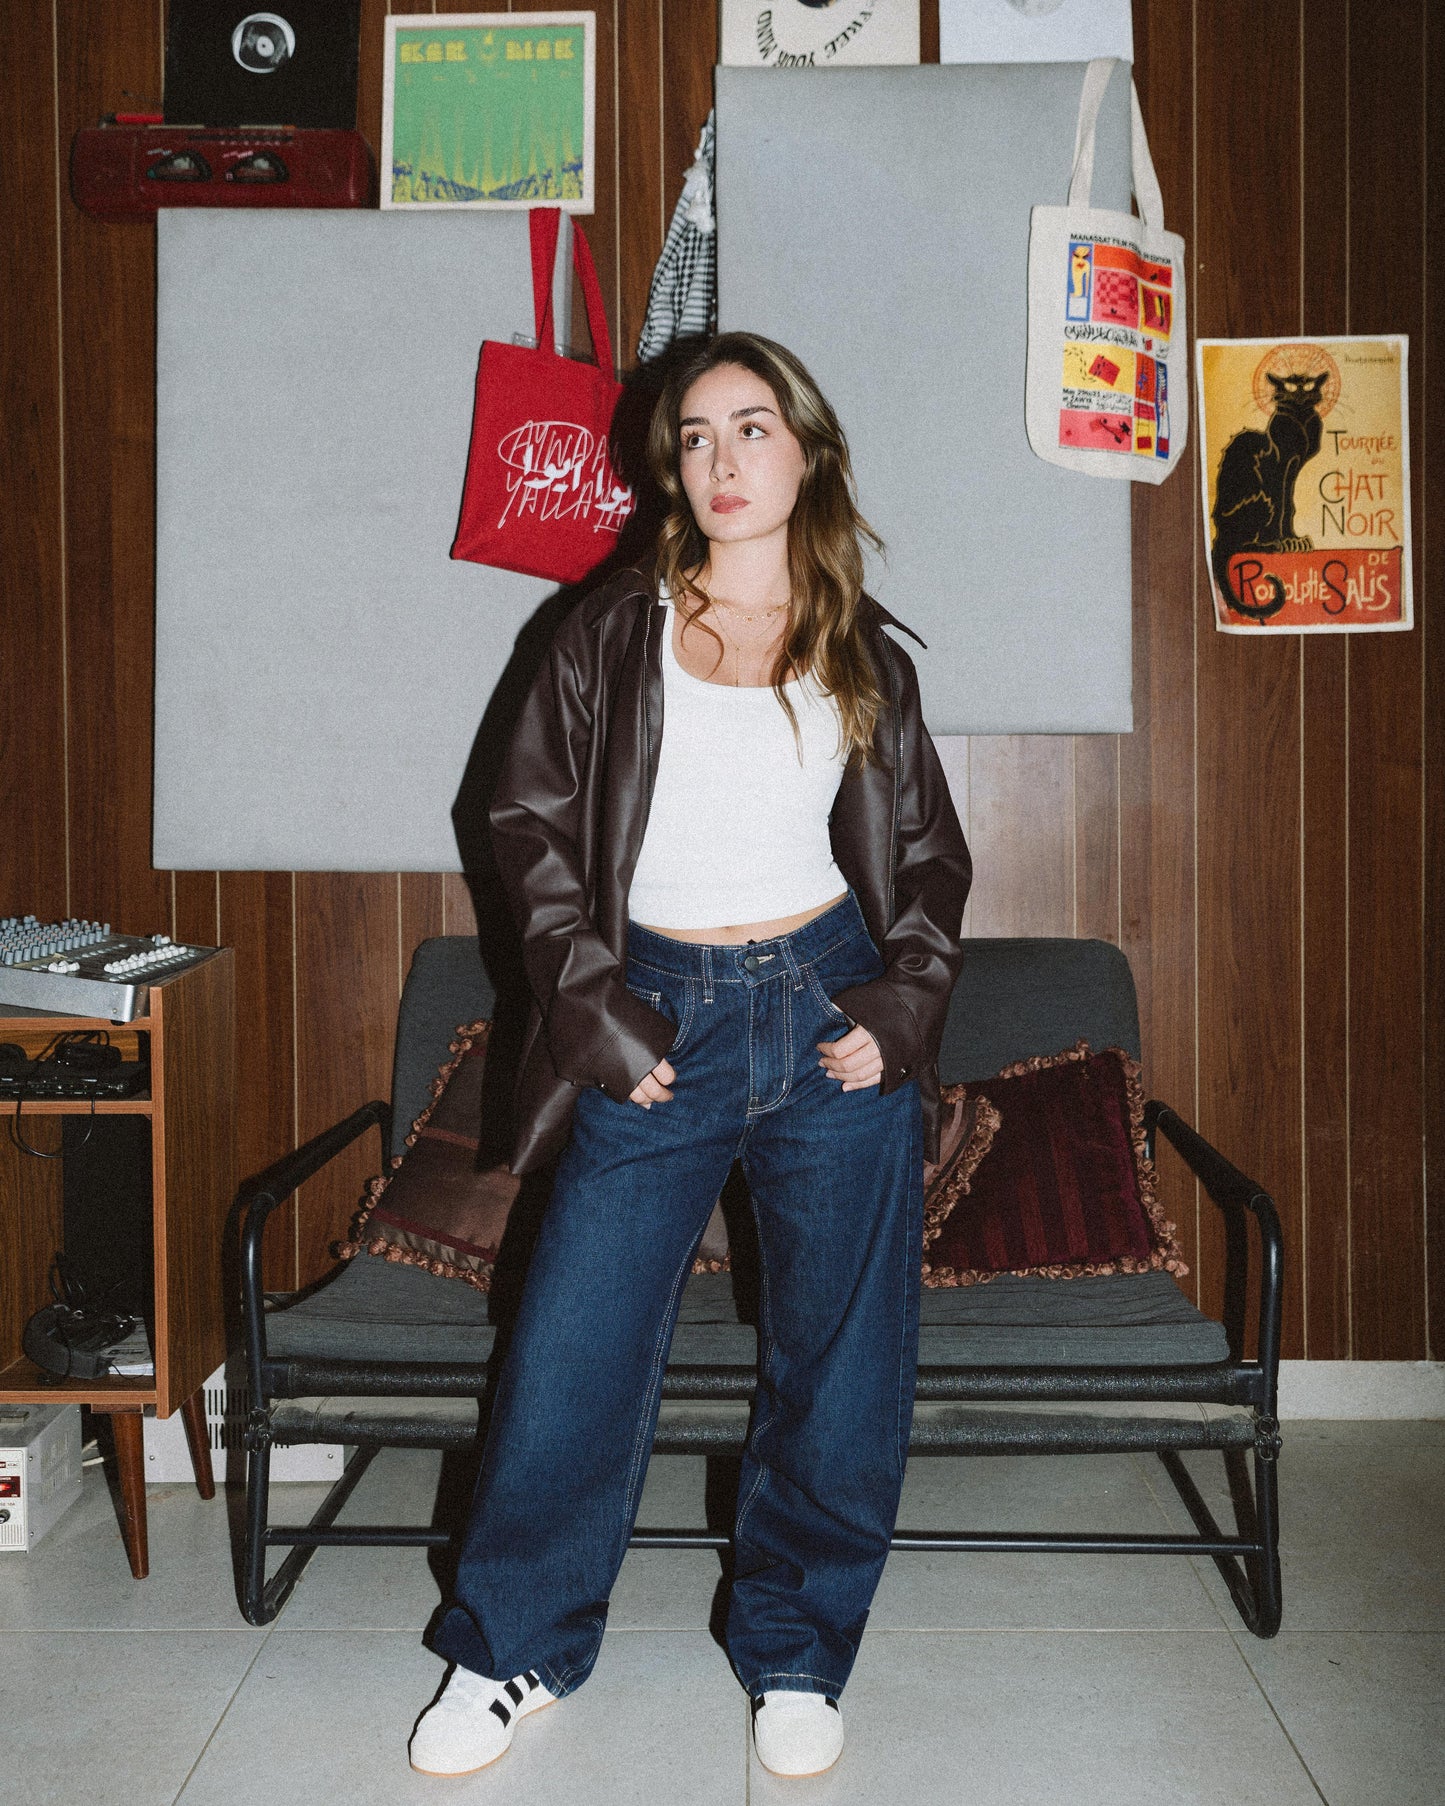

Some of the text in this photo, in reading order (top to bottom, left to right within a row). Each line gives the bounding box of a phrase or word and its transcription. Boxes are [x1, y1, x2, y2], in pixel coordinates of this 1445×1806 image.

[758, 10, 778, 59] MIND
[825, 10, 872, 59] FREE
[1319, 467, 1390, 513] CHAT
[1322, 504, 1399, 541] NOIR
[1367, 552, 1389, 566] DE
